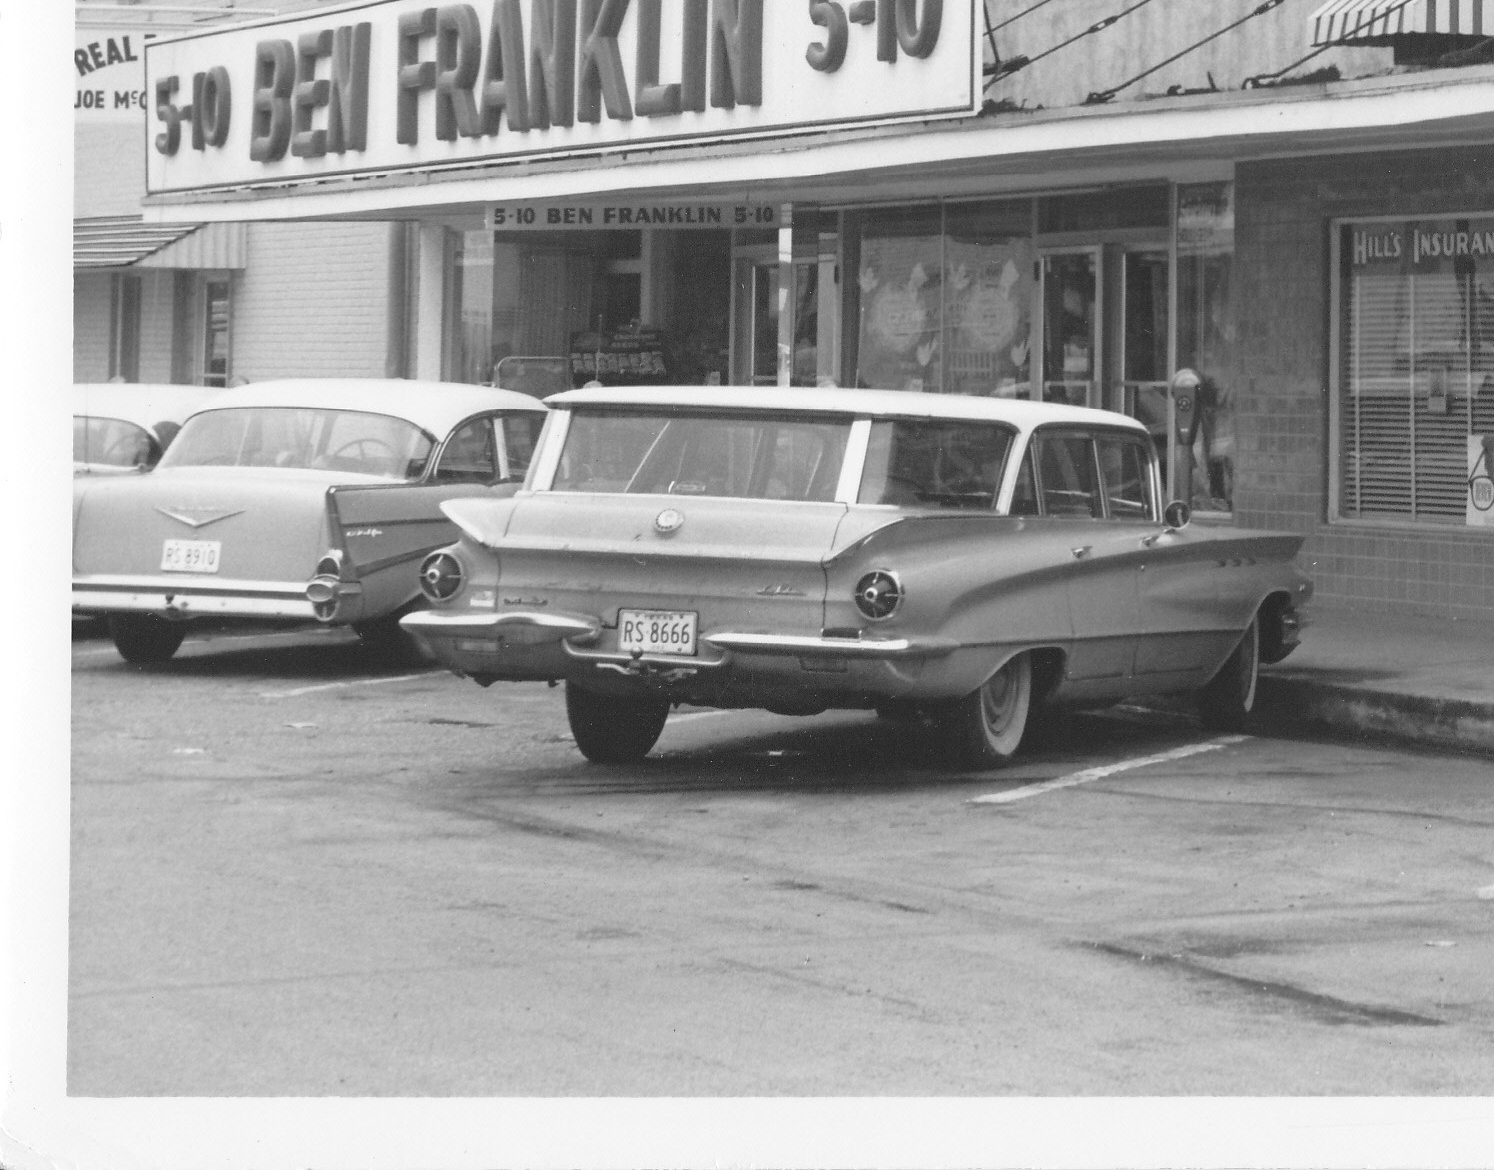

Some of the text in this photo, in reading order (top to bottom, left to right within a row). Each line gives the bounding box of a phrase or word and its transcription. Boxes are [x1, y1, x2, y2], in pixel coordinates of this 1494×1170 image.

[74, 35, 138, 77] REAL
[74, 90, 105, 109] JOE
[250, 21, 372, 163] BEN
[547, 207, 593, 225] BEN
[603, 206, 721, 225] FRANKLIN
[624, 621, 690, 644] RS 8666
